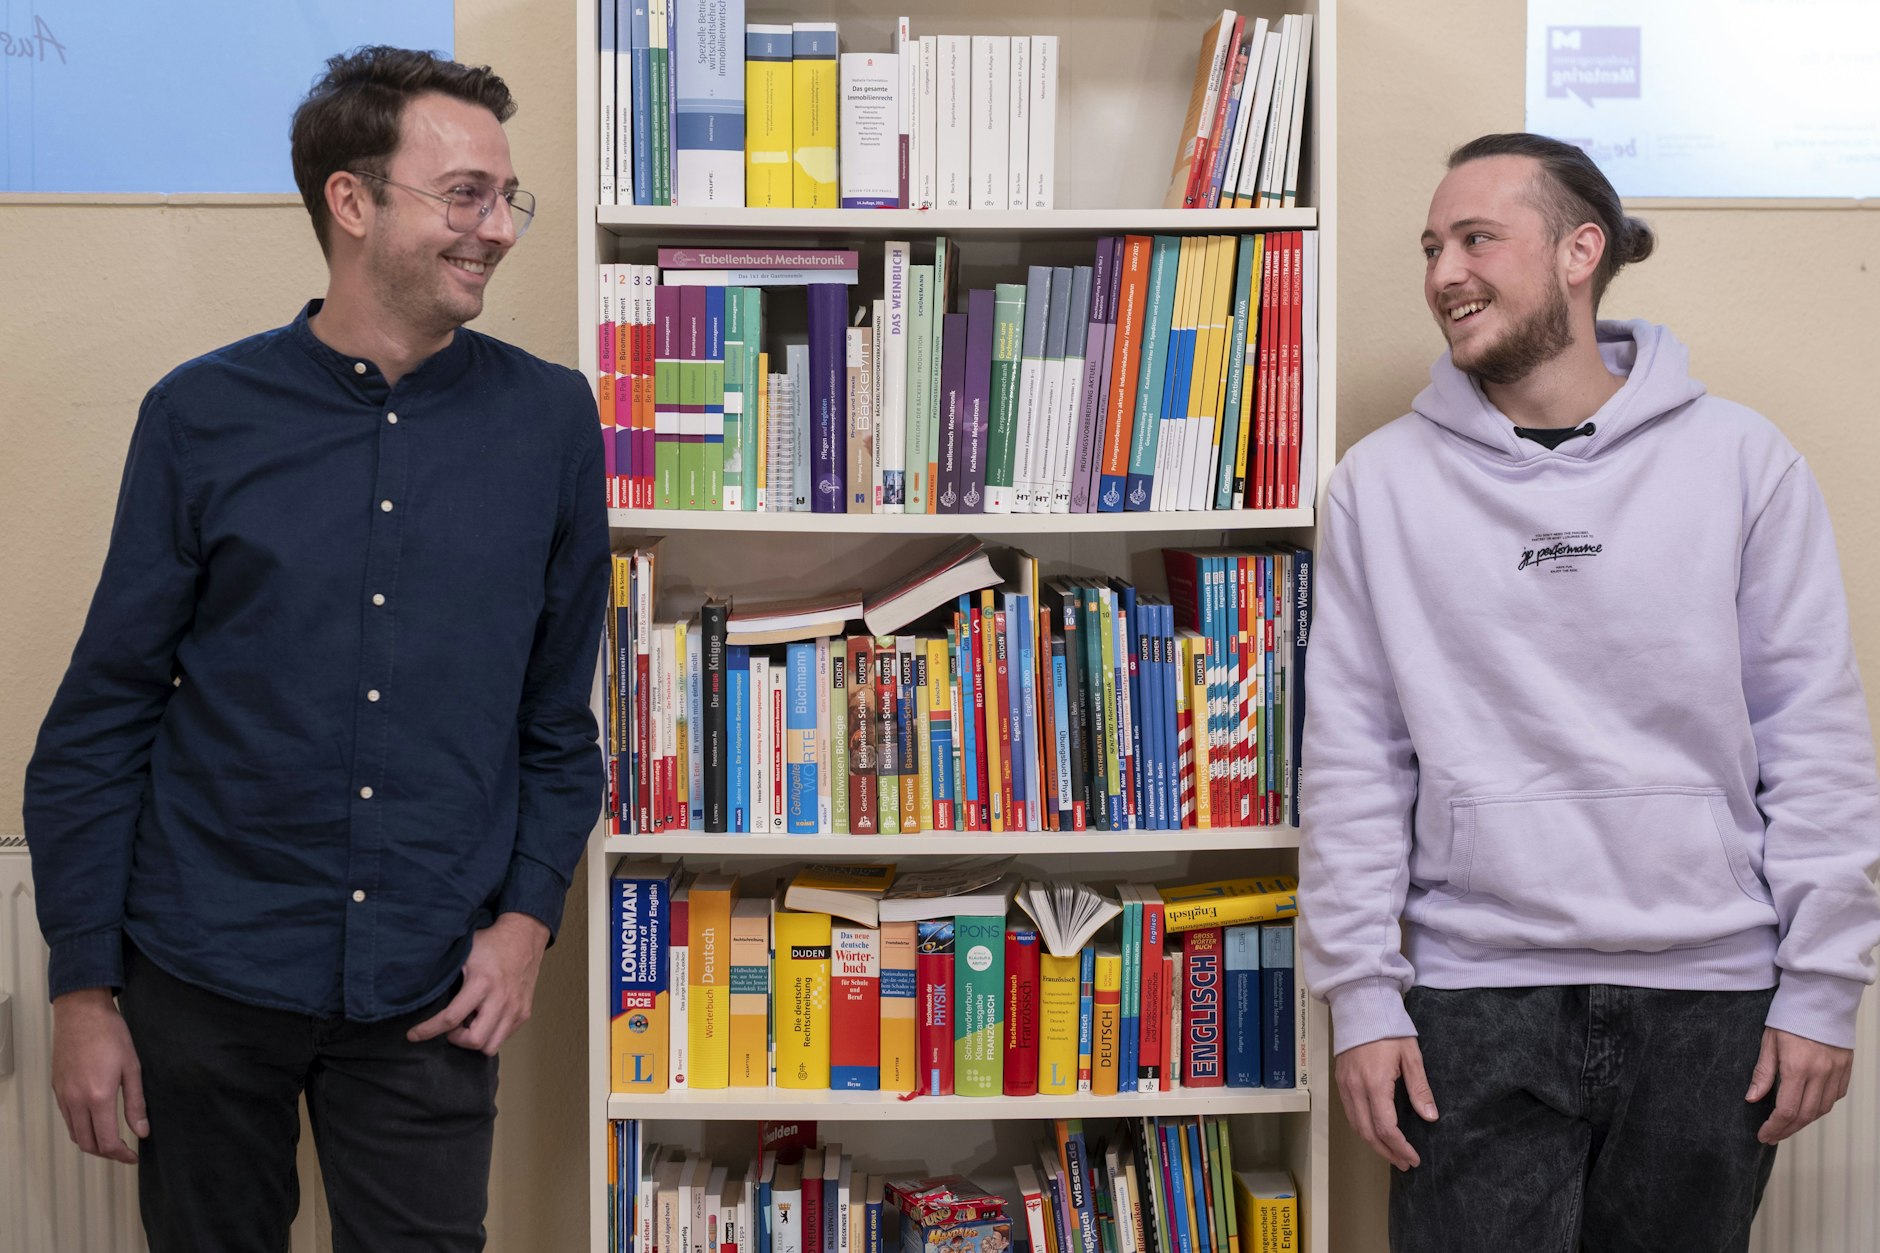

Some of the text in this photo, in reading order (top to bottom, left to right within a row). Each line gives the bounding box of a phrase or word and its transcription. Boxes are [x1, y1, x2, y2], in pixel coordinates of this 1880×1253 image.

[698, 27, 707, 64] Spezielle
[708, 3, 716, 70] wirtschaftslehre
[619, 274, 626, 285] 2
[634, 275, 641, 286] 3
[699, 254, 845, 266] Tabellenbuch Mechatronik
[1131, 242, 1140, 272] 2020/2021
[1292, 249, 1300, 305] PRÜFUNGSTRAINER
[891, 250, 902, 335] DAS WEINBUCH
[1238, 300, 1246, 318] JAVA
[601, 296, 611, 359] Büromanagement
[619, 298, 628, 361] Büromanagement
[633, 299, 642, 362] Büromanagement
[998, 322, 1007, 359] Grund- und
[1005, 323, 1014, 359] Fachwissen
[1234, 333, 1243, 368] Informatik
[821, 398, 829, 425] Begleiten
[857, 343, 870, 430] Bäcker/in
[997, 363, 1009, 433] Zerspanungsmechanik
[1116, 388, 1124, 408] aktuell
[1141, 394, 1149, 412] aktuell
[1230, 369, 1239, 404] Praktische
[946, 390, 956, 472] Tabellenbuch Mechatronik
[970, 398, 980, 472] Fachkunde Mechatronik
[1079, 360, 1097, 472] PRÜFUNGSVORBEREITUNG AKTUELL
[1110, 409, 1124, 471] Prüfungsvorbereitung
[1135, 413, 1148, 466] Prüfungsvorbereitung
[1144, 412, 1154, 446] Gesamtpaket
[821, 437, 829, 460] Pflegen
[1222, 464, 1232, 493] Cornelsen
[1537, 543, 1602, 566] performance
[1297, 563, 1309, 647] Diercke Weltatlas
[708, 635, 721, 670] Knigge
[1141, 638, 1149, 660] DUDEN
[1196, 659, 1204, 685] DUDEN
[690, 652, 700, 753] Ihr versteht mich einfach nicht!
[711, 694, 720, 707] Der
[735, 672, 743, 721] Bewerbungsmappe
[795, 651, 807, 714] Büchmann
[640, 672, 648, 831] campus Einstellungstest Ausbildungsplatzsuche
[735, 723, 743, 753] erfolgreiche
[835, 662, 845, 813] Schulwissen Biologie DUDEN
[858, 657, 868, 812] Geschichte Basiswissen Schule DUDEN
[902, 657, 915, 812] Chemie DUDEN
[803, 730, 816, 793] WORTE
[1199, 752, 1208, 809] Schulwissen
[791, 763, 804, 816] Geflügelte
[621, 883, 637, 983] LONGMAN
[648, 884, 659, 982] Contemporary English
[840, 932, 870, 940] Das neue
[960, 925, 1000, 938] PONS
[1169, 907, 1217, 922] Englisch
[638, 926, 648, 982] Dictionary of
[793, 949, 825, 958] DUDEN
[836, 949, 874, 963] Wörter-
[844, 963, 866, 974] buch
[627, 998, 651, 1008] DCE
[702, 928, 714, 1038] Wörterbuch Deutsch
[794, 977, 802, 1032] Die deutsche
[934, 984, 946, 1026] PHYSIK
[803, 977, 812, 1047] Rechtschreibung
[965, 983, 973, 1060] Schülerwörterbuch
[975, 994, 984, 1060] Klausurausgabe
[985, 994, 995, 1060] FRANZÖSISCH
[1190, 955, 1219, 1078] ENGLISCH
[1101, 1011, 1112, 1068] DEUTSCH
[1067, 1142, 1083, 1207] wissen.de
[1133, 1202, 1145, 1252] Bilderlexikon
[1281, 1206, 1292, 1249] Englisch
